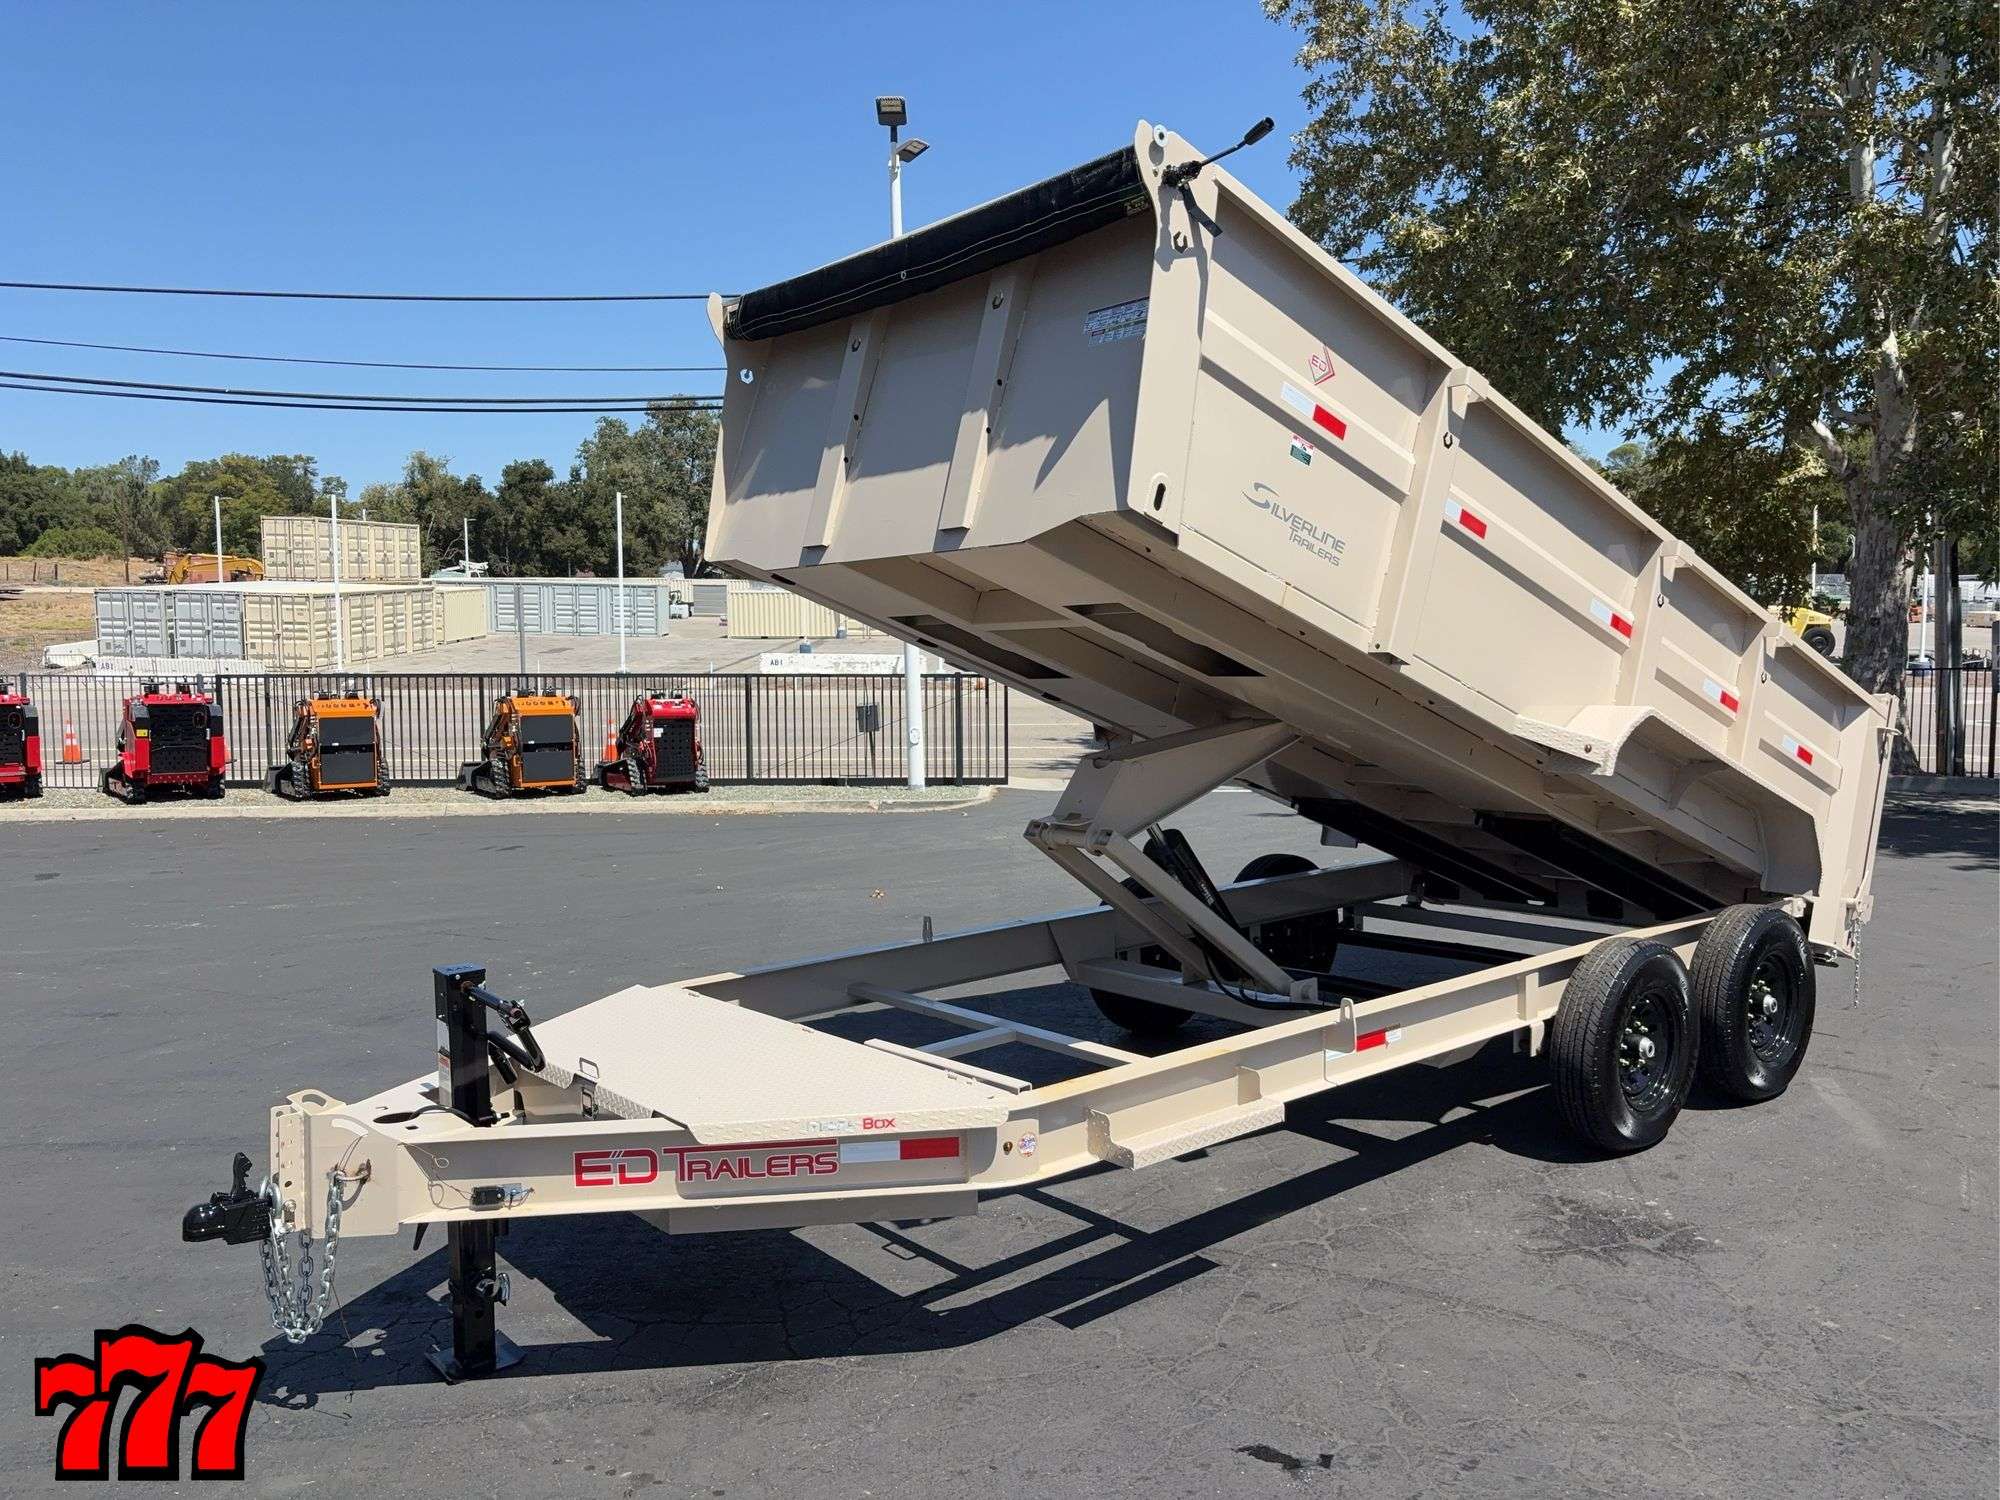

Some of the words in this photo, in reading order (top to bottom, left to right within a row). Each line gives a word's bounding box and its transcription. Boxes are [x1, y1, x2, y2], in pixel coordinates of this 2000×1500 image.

[1241, 482, 1346, 555] SILVERLINE
[1289, 526, 1341, 567] TRAILERS
[574, 1148, 660, 1187] ED
[663, 1138, 838, 1182] TRAILERS
